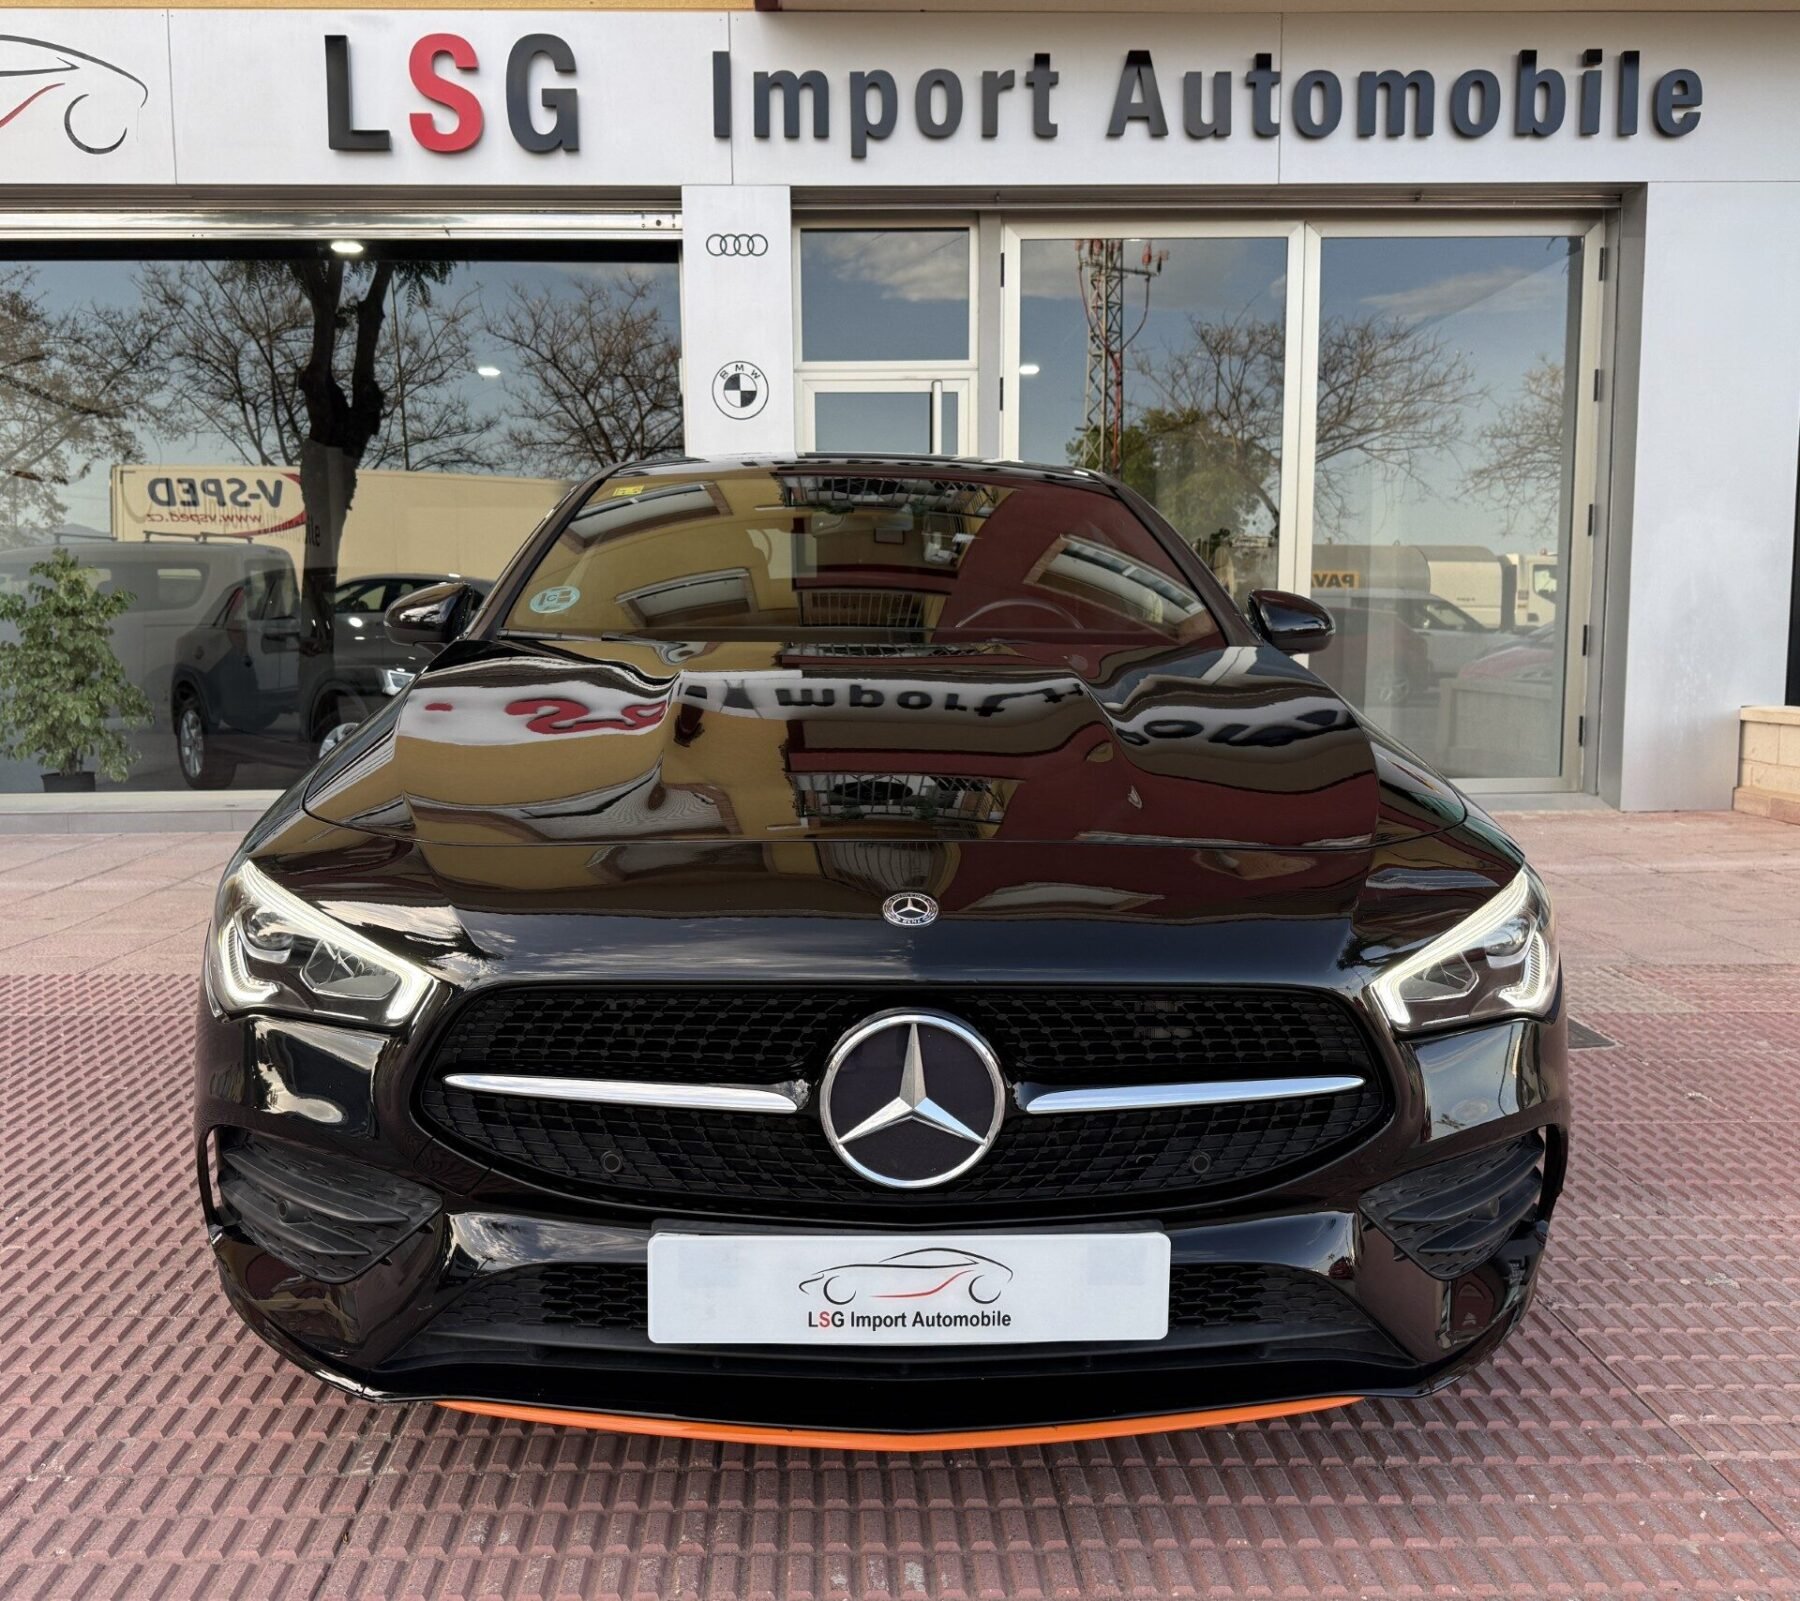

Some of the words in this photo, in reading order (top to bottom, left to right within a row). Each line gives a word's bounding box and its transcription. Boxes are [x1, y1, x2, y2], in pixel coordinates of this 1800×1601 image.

[324, 33, 580, 153] LSG
[712, 49, 1060, 159] Import
[1106, 48, 1704, 138] Automobile
[719, 364, 761, 380] BMW
[807, 1311, 845, 1328] LSG
[850, 1311, 907, 1331] Import
[911, 1310, 1012, 1327] Automobile
